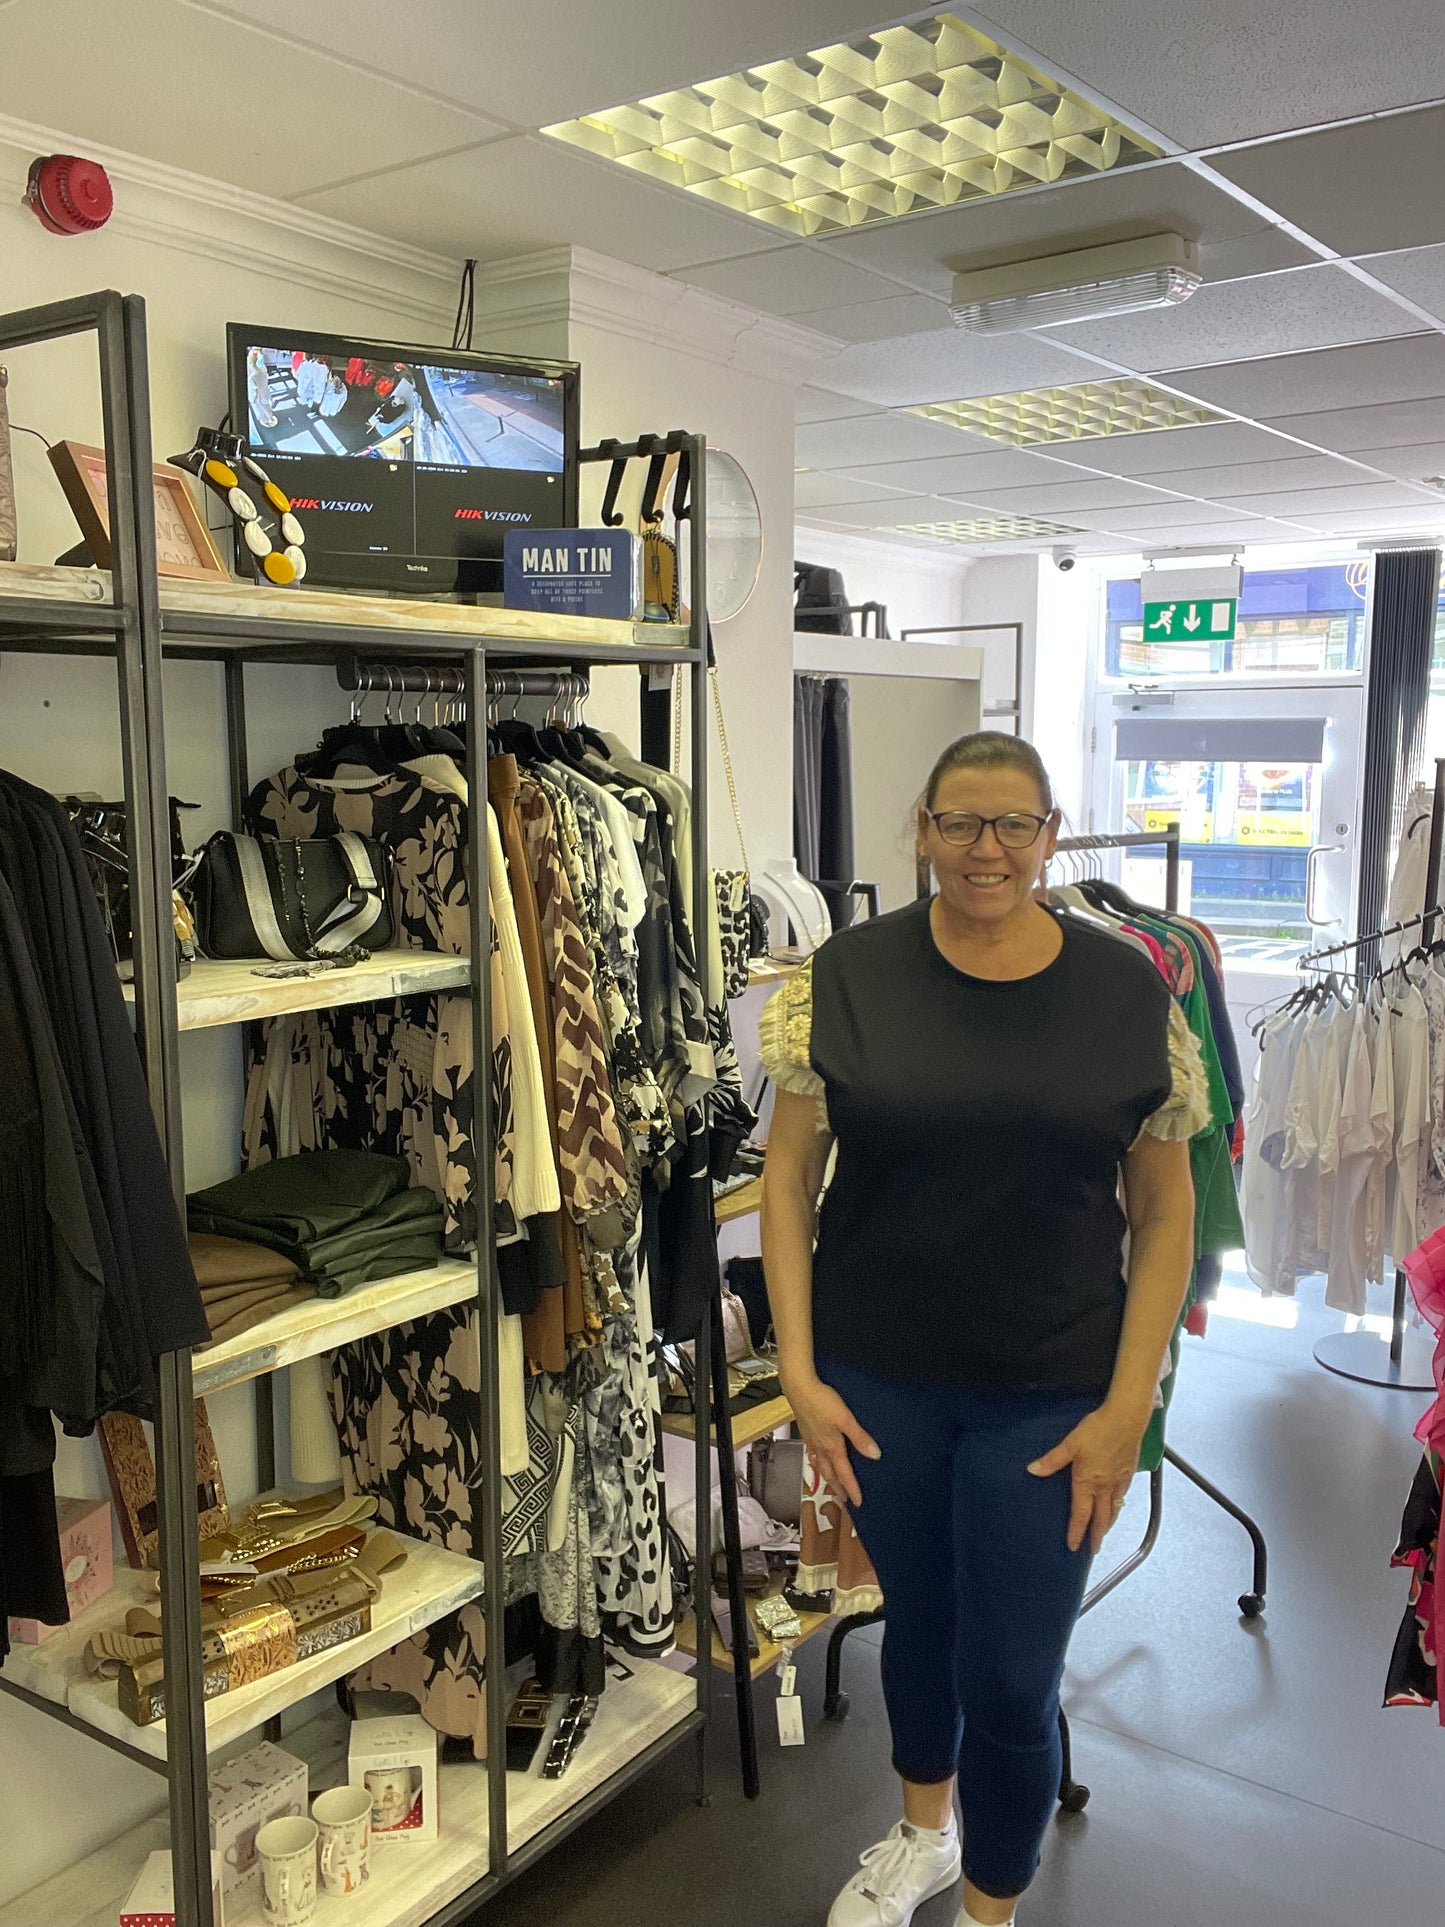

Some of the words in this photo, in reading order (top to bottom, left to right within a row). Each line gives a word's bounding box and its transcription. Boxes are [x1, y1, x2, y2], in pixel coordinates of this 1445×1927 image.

[289, 497, 373, 513] HIKVISION
[454, 508, 532, 522] HIKVISION
[522, 547, 568, 573] MAN
[576, 547, 612, 572] TIN
